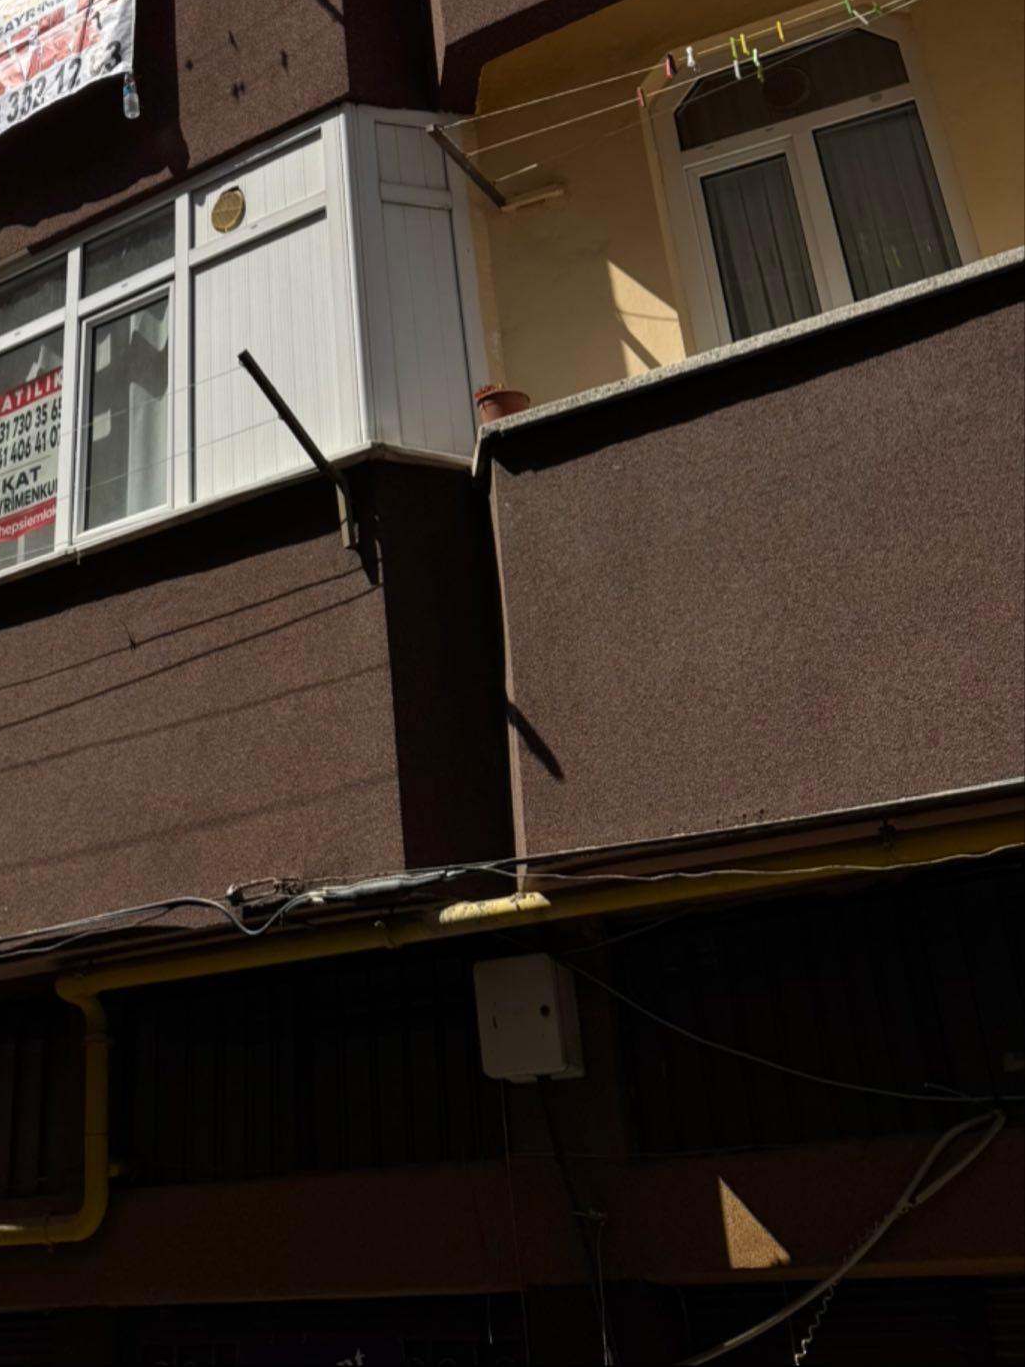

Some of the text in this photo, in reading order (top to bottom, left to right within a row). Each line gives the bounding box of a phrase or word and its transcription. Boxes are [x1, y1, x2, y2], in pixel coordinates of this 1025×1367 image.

[13, 410, 33, 438] 730
[35, 403, 48, 428] 35
[10, 436, 31, 463] 406
[34, 429, 47, 454] 41
[2, 464, 42, 494] KAT
